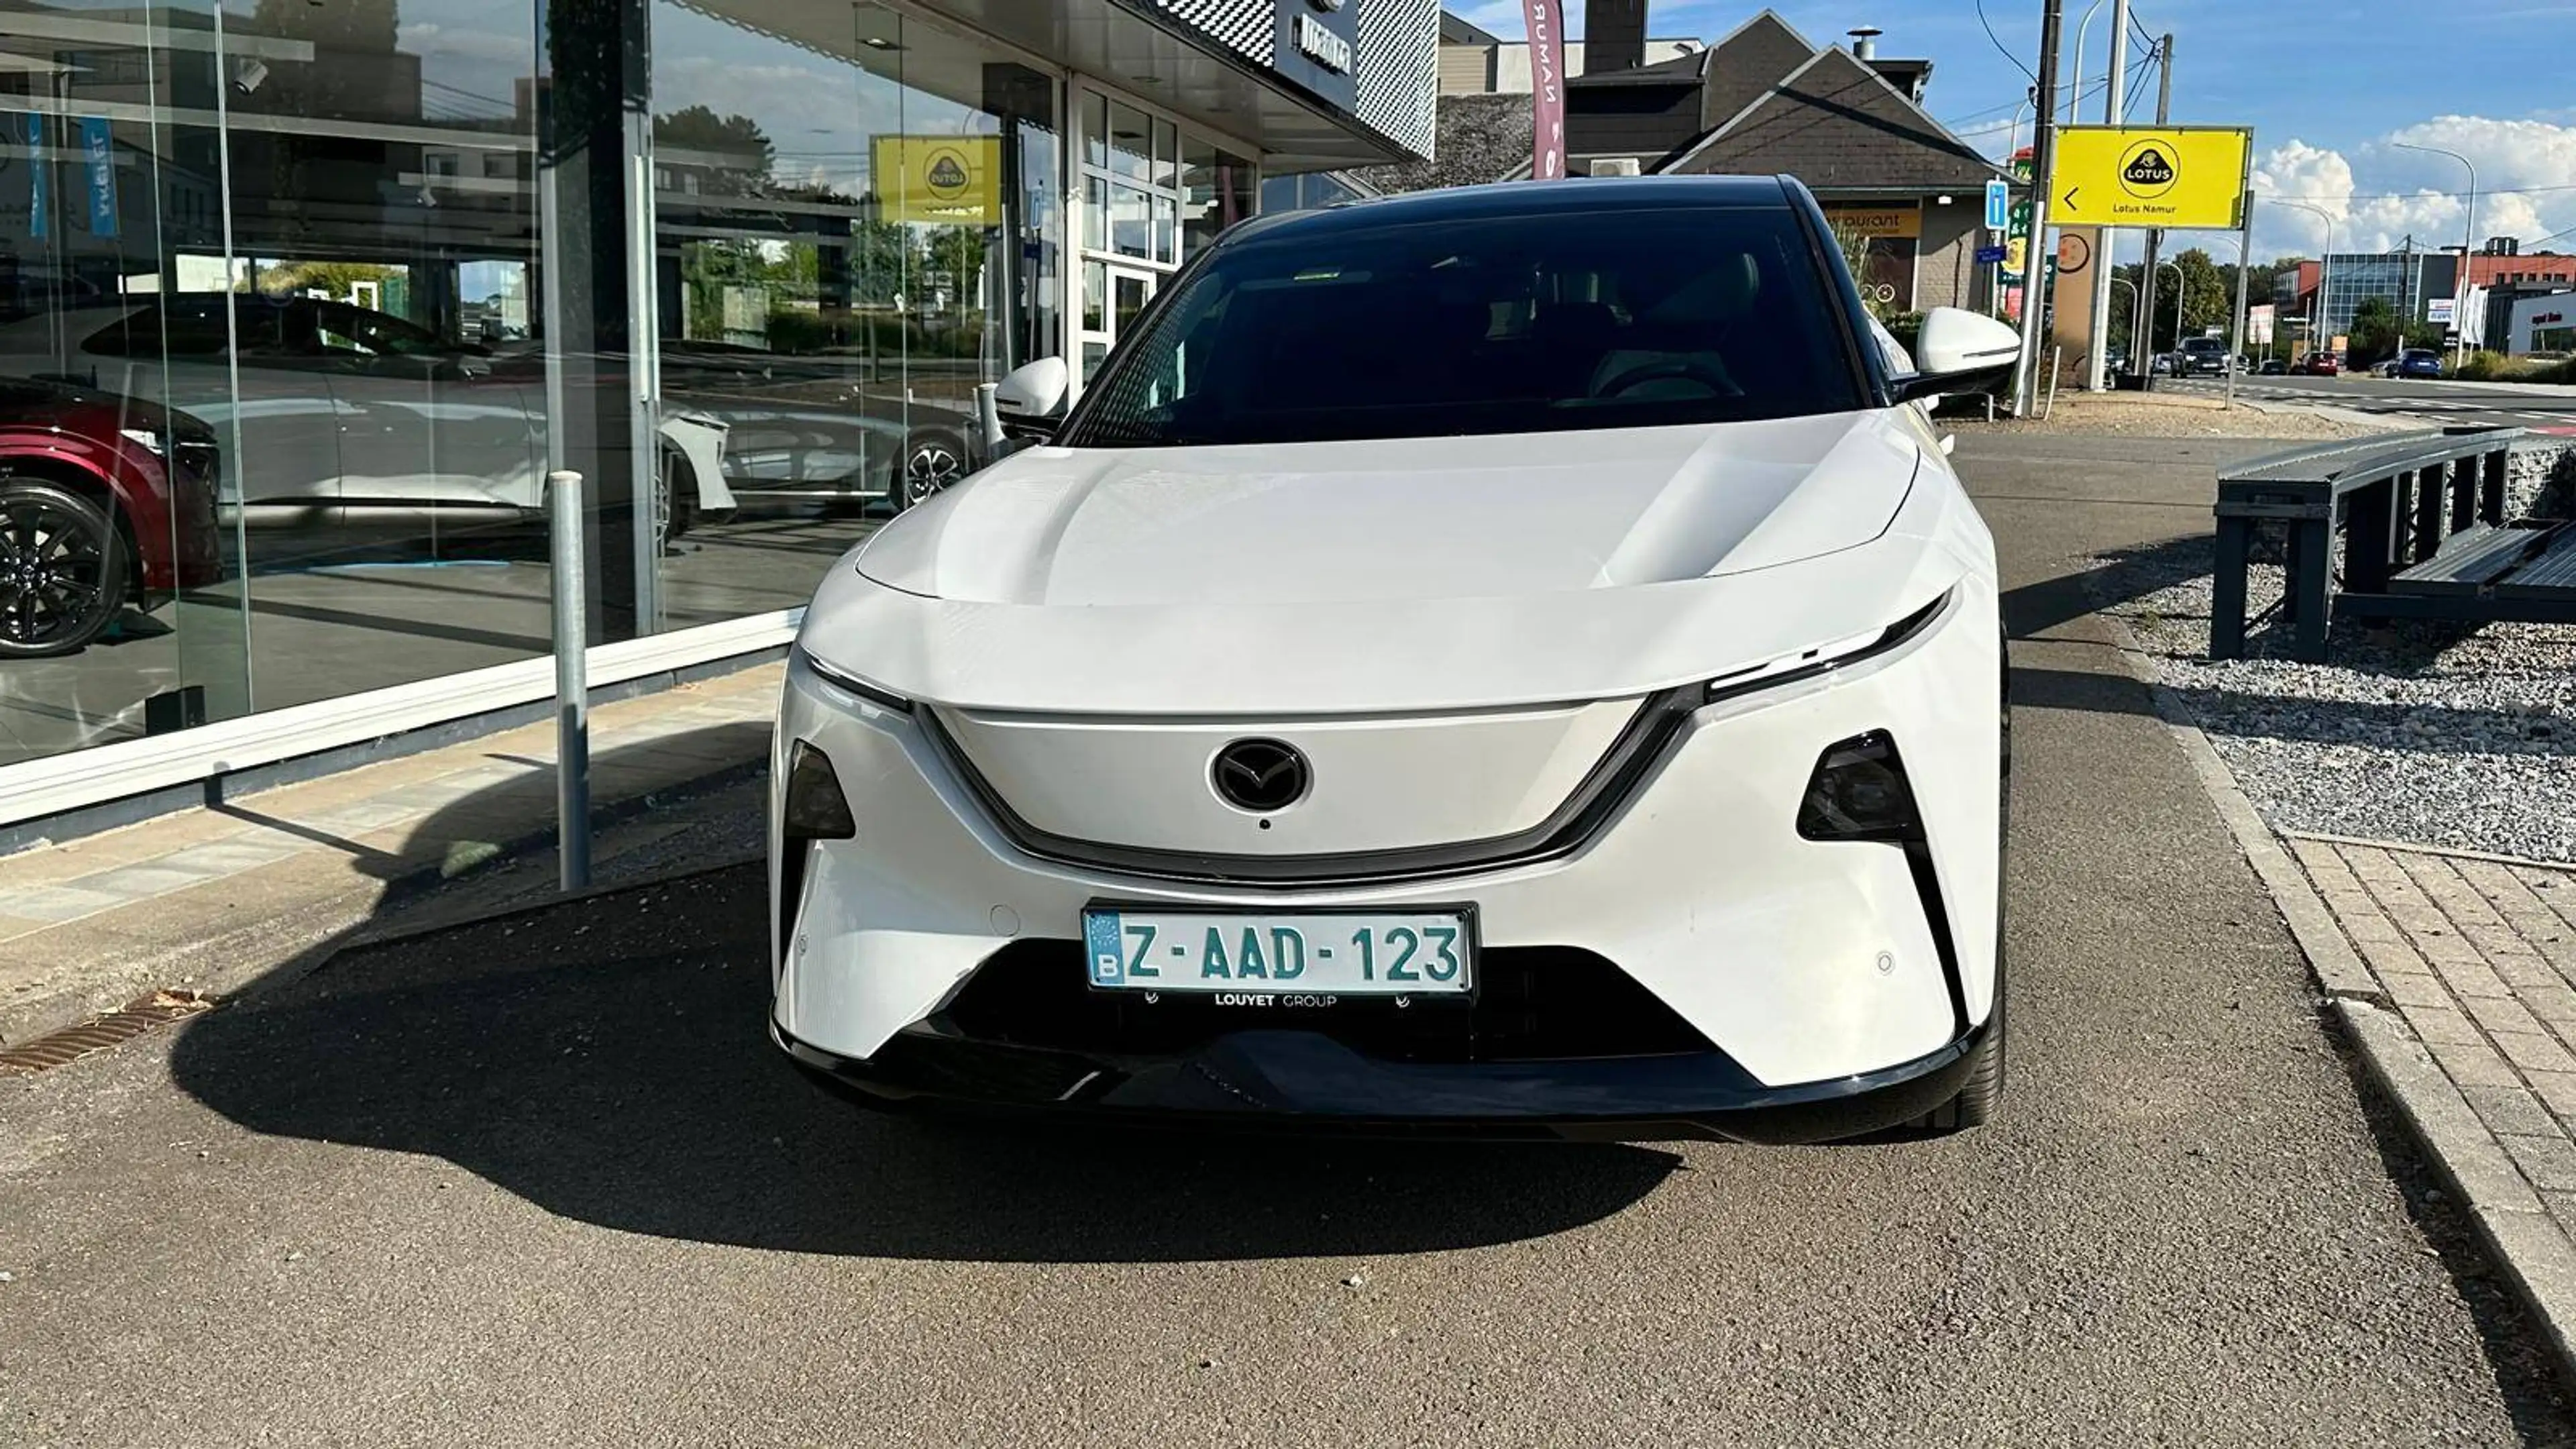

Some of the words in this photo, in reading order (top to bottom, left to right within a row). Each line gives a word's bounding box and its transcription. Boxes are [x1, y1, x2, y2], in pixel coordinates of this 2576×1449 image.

[2127, 168, 2171, 180] LOTUS
[2113, 203, 2140, 213] Lotus
[2143, 204, 2177, 213] Namur
[1097, 954, 1119, 977] B
[1125, 925, 1459, 981] Z-AAD-123
[1215, 994, 1274, 1006] LOUYET
[1283, 995, 1337, 1006] GROUP
